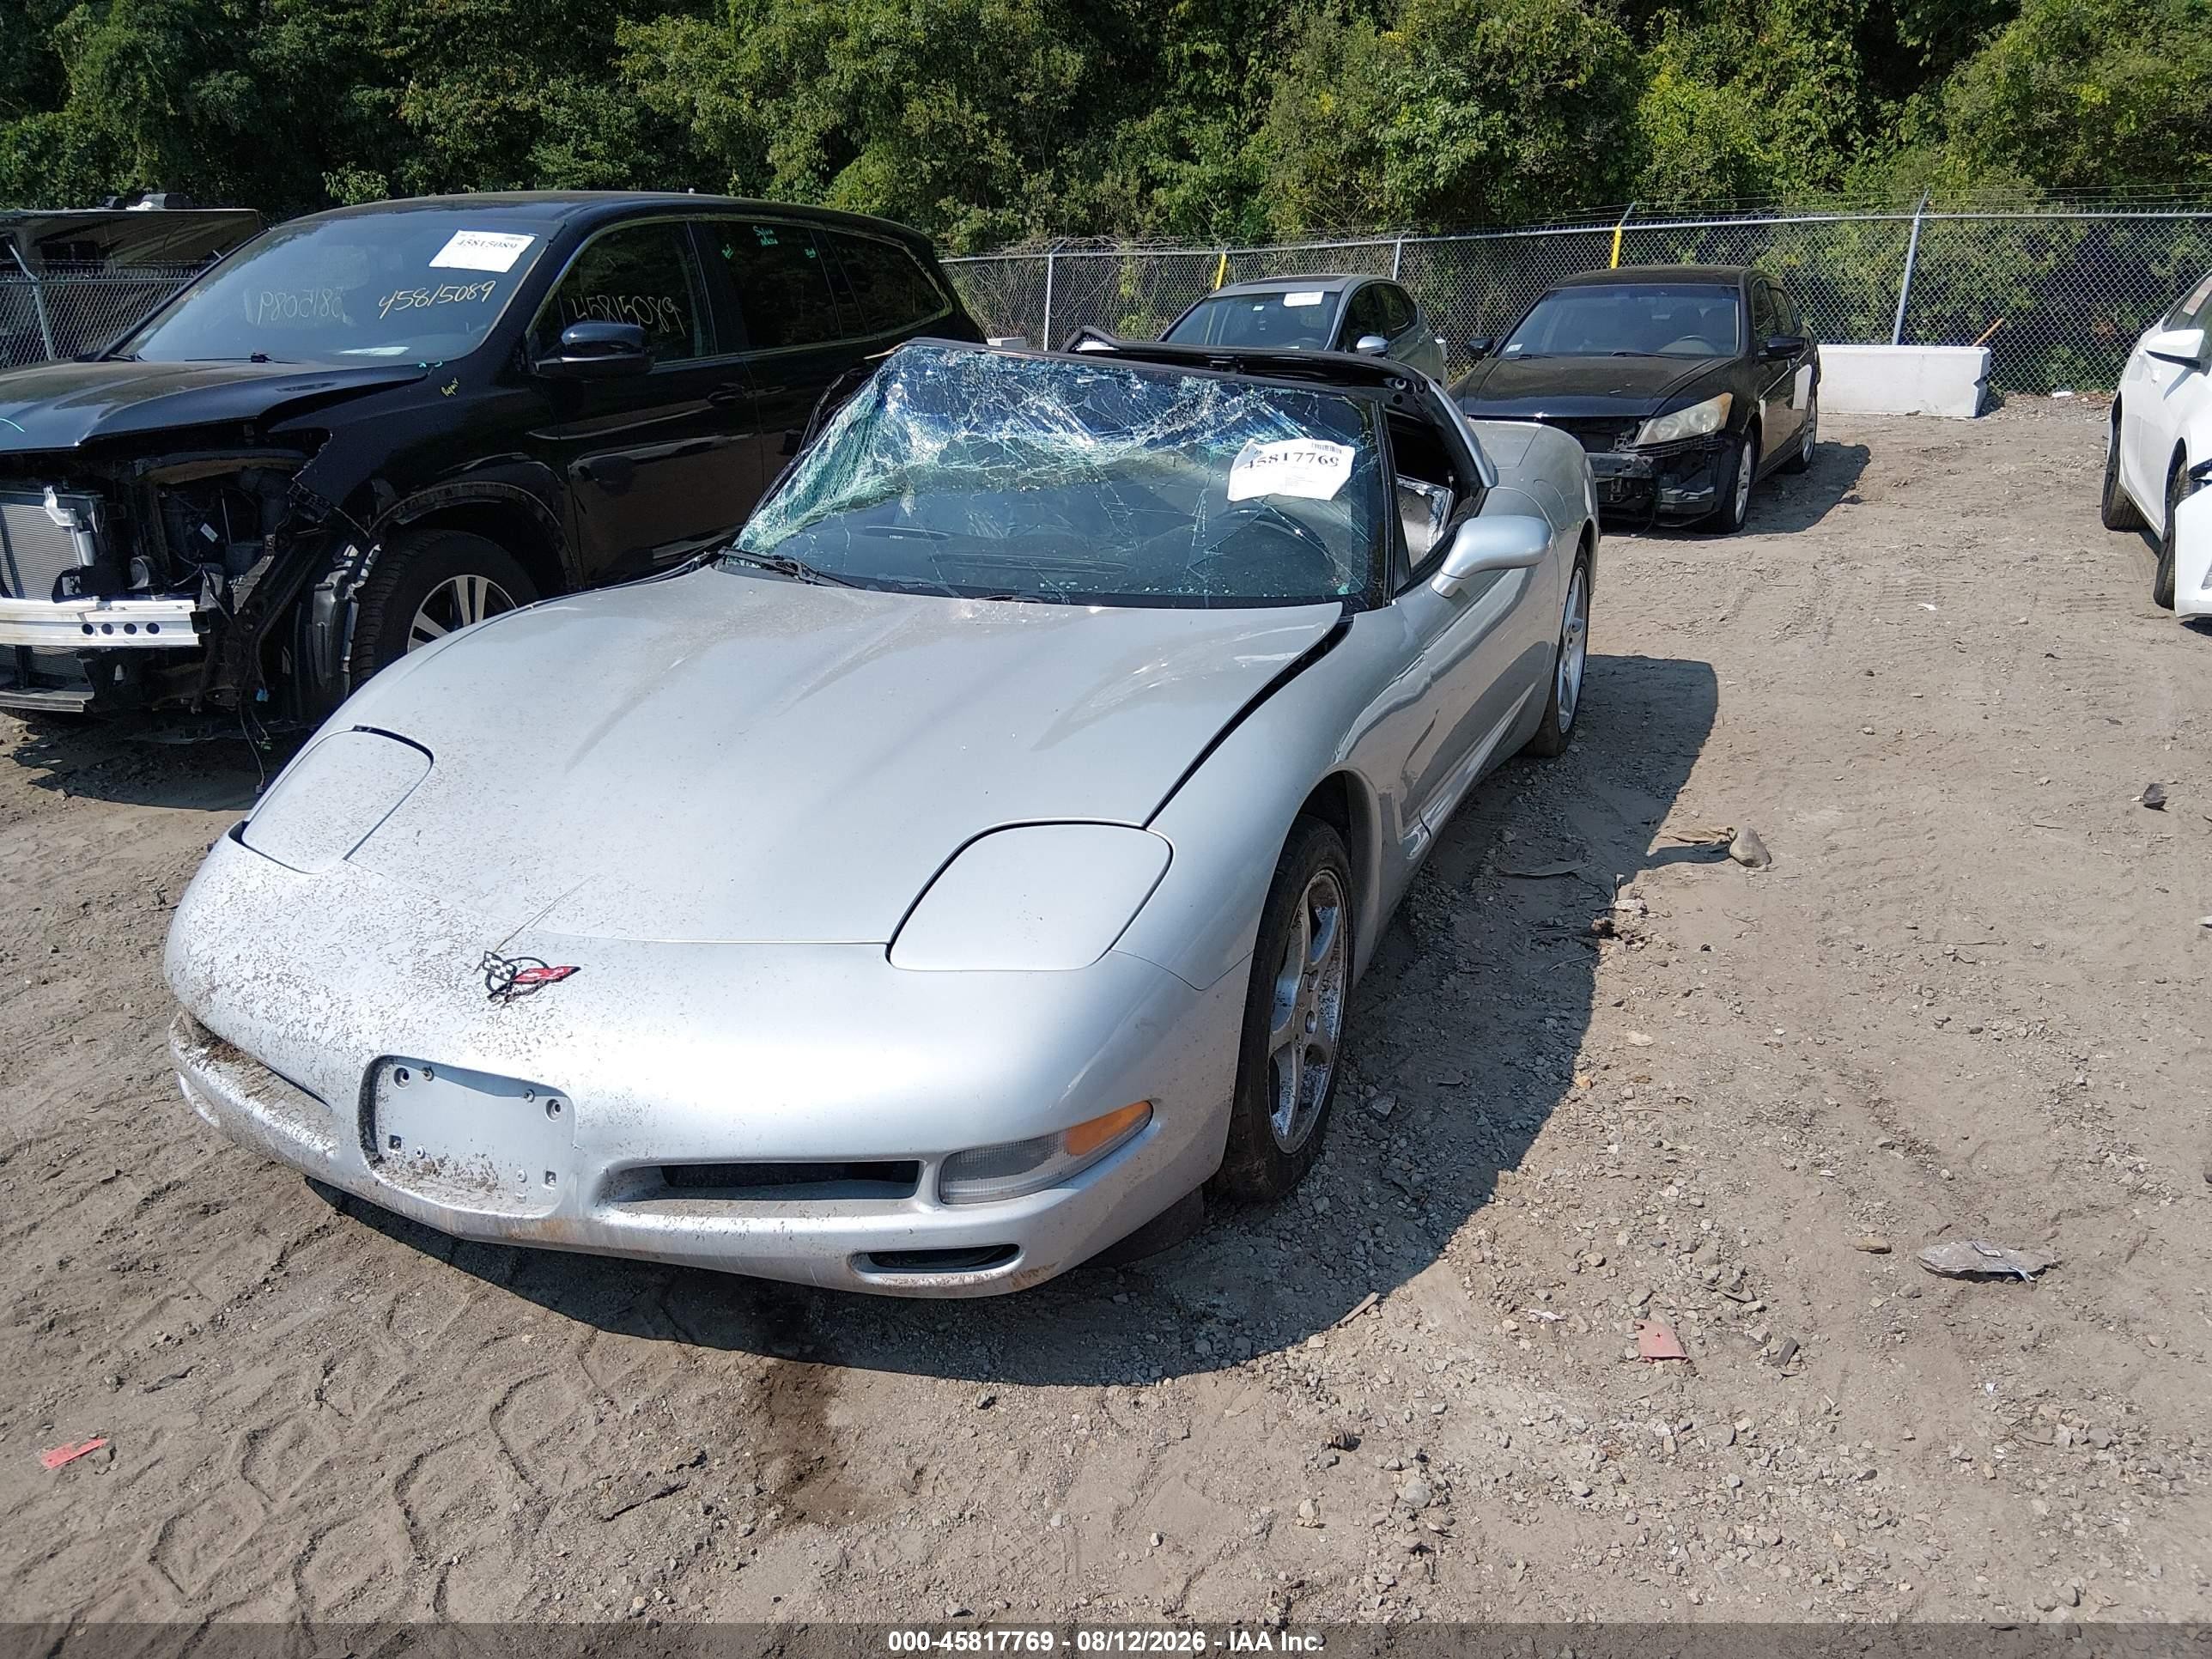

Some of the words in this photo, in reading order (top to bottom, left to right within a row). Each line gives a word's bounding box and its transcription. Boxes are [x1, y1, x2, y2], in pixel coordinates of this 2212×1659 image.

[378, 280, 497, 319] 45815089
[570, 294, 687, 337] 45815089
[1243, 452, 1340, 469] 45817769
